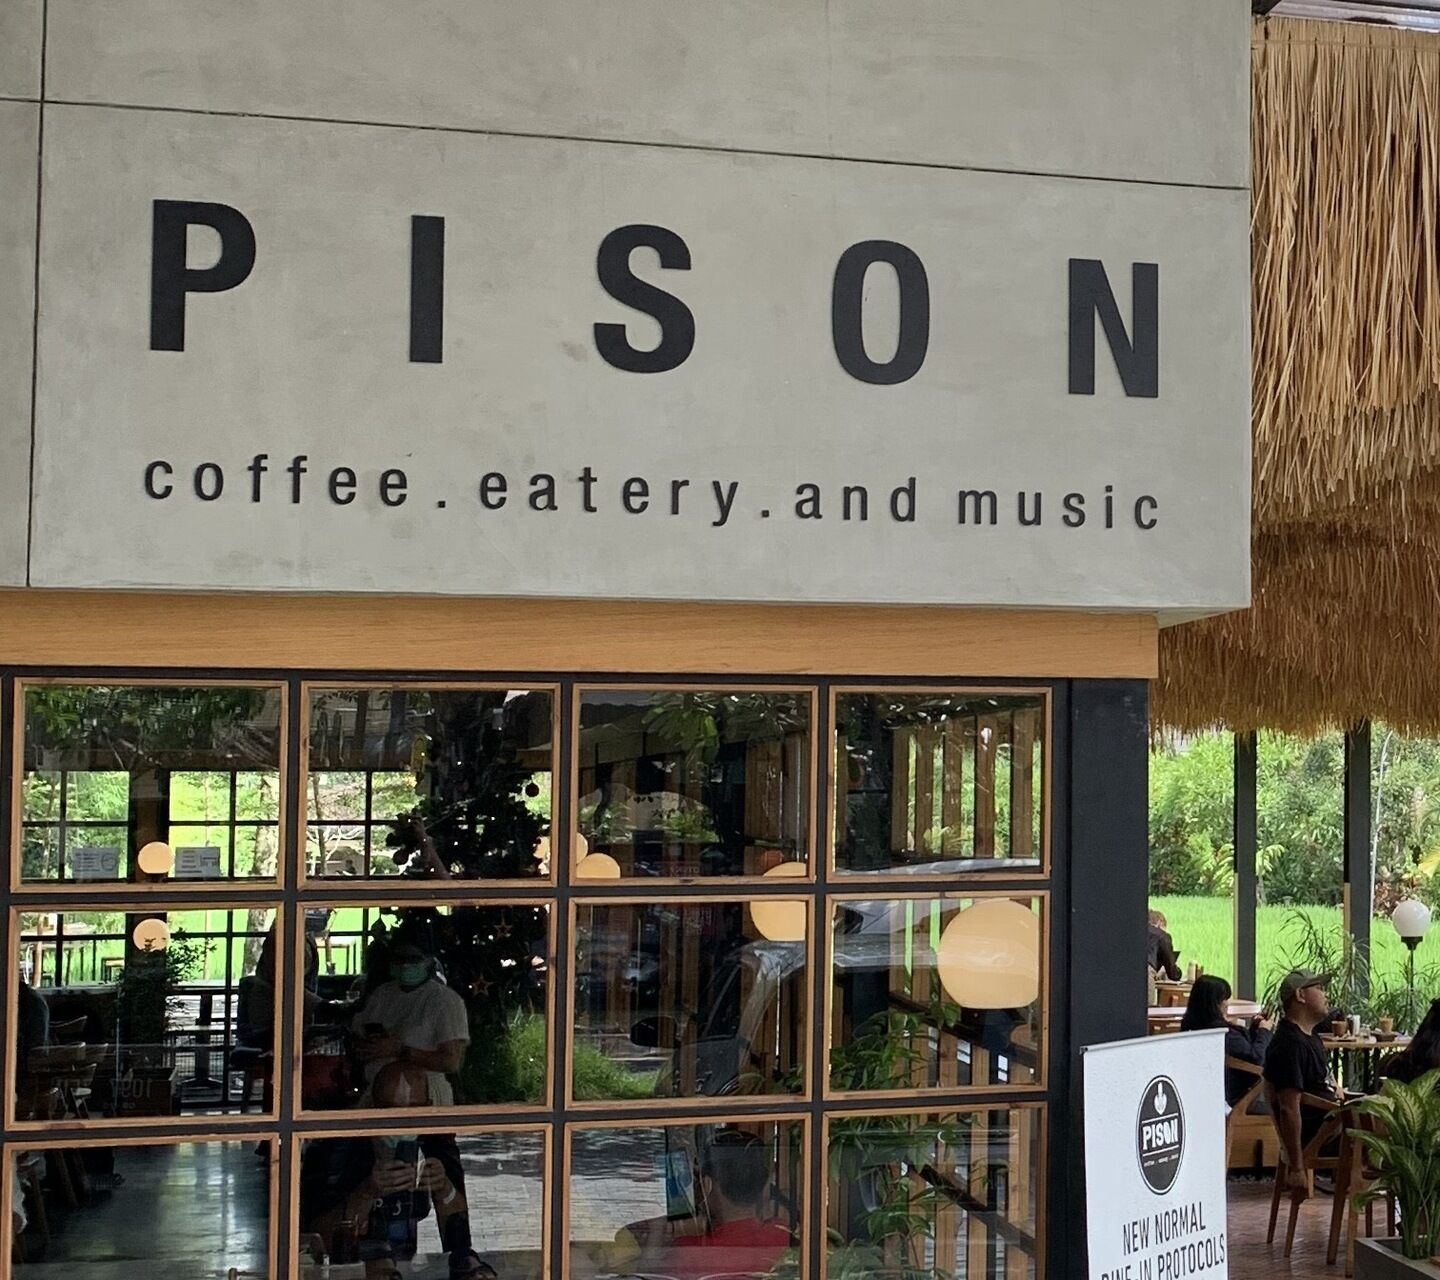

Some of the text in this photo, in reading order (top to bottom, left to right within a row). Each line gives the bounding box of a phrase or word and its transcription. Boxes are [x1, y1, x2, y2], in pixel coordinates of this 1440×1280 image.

[149, 198, 1159, 400] PISON
[957, 489, 1159, 531] music
[1142, 1119, 1179, 1150] PISON
[1123, 1201, 1207, 1257] NEW NORMAL
